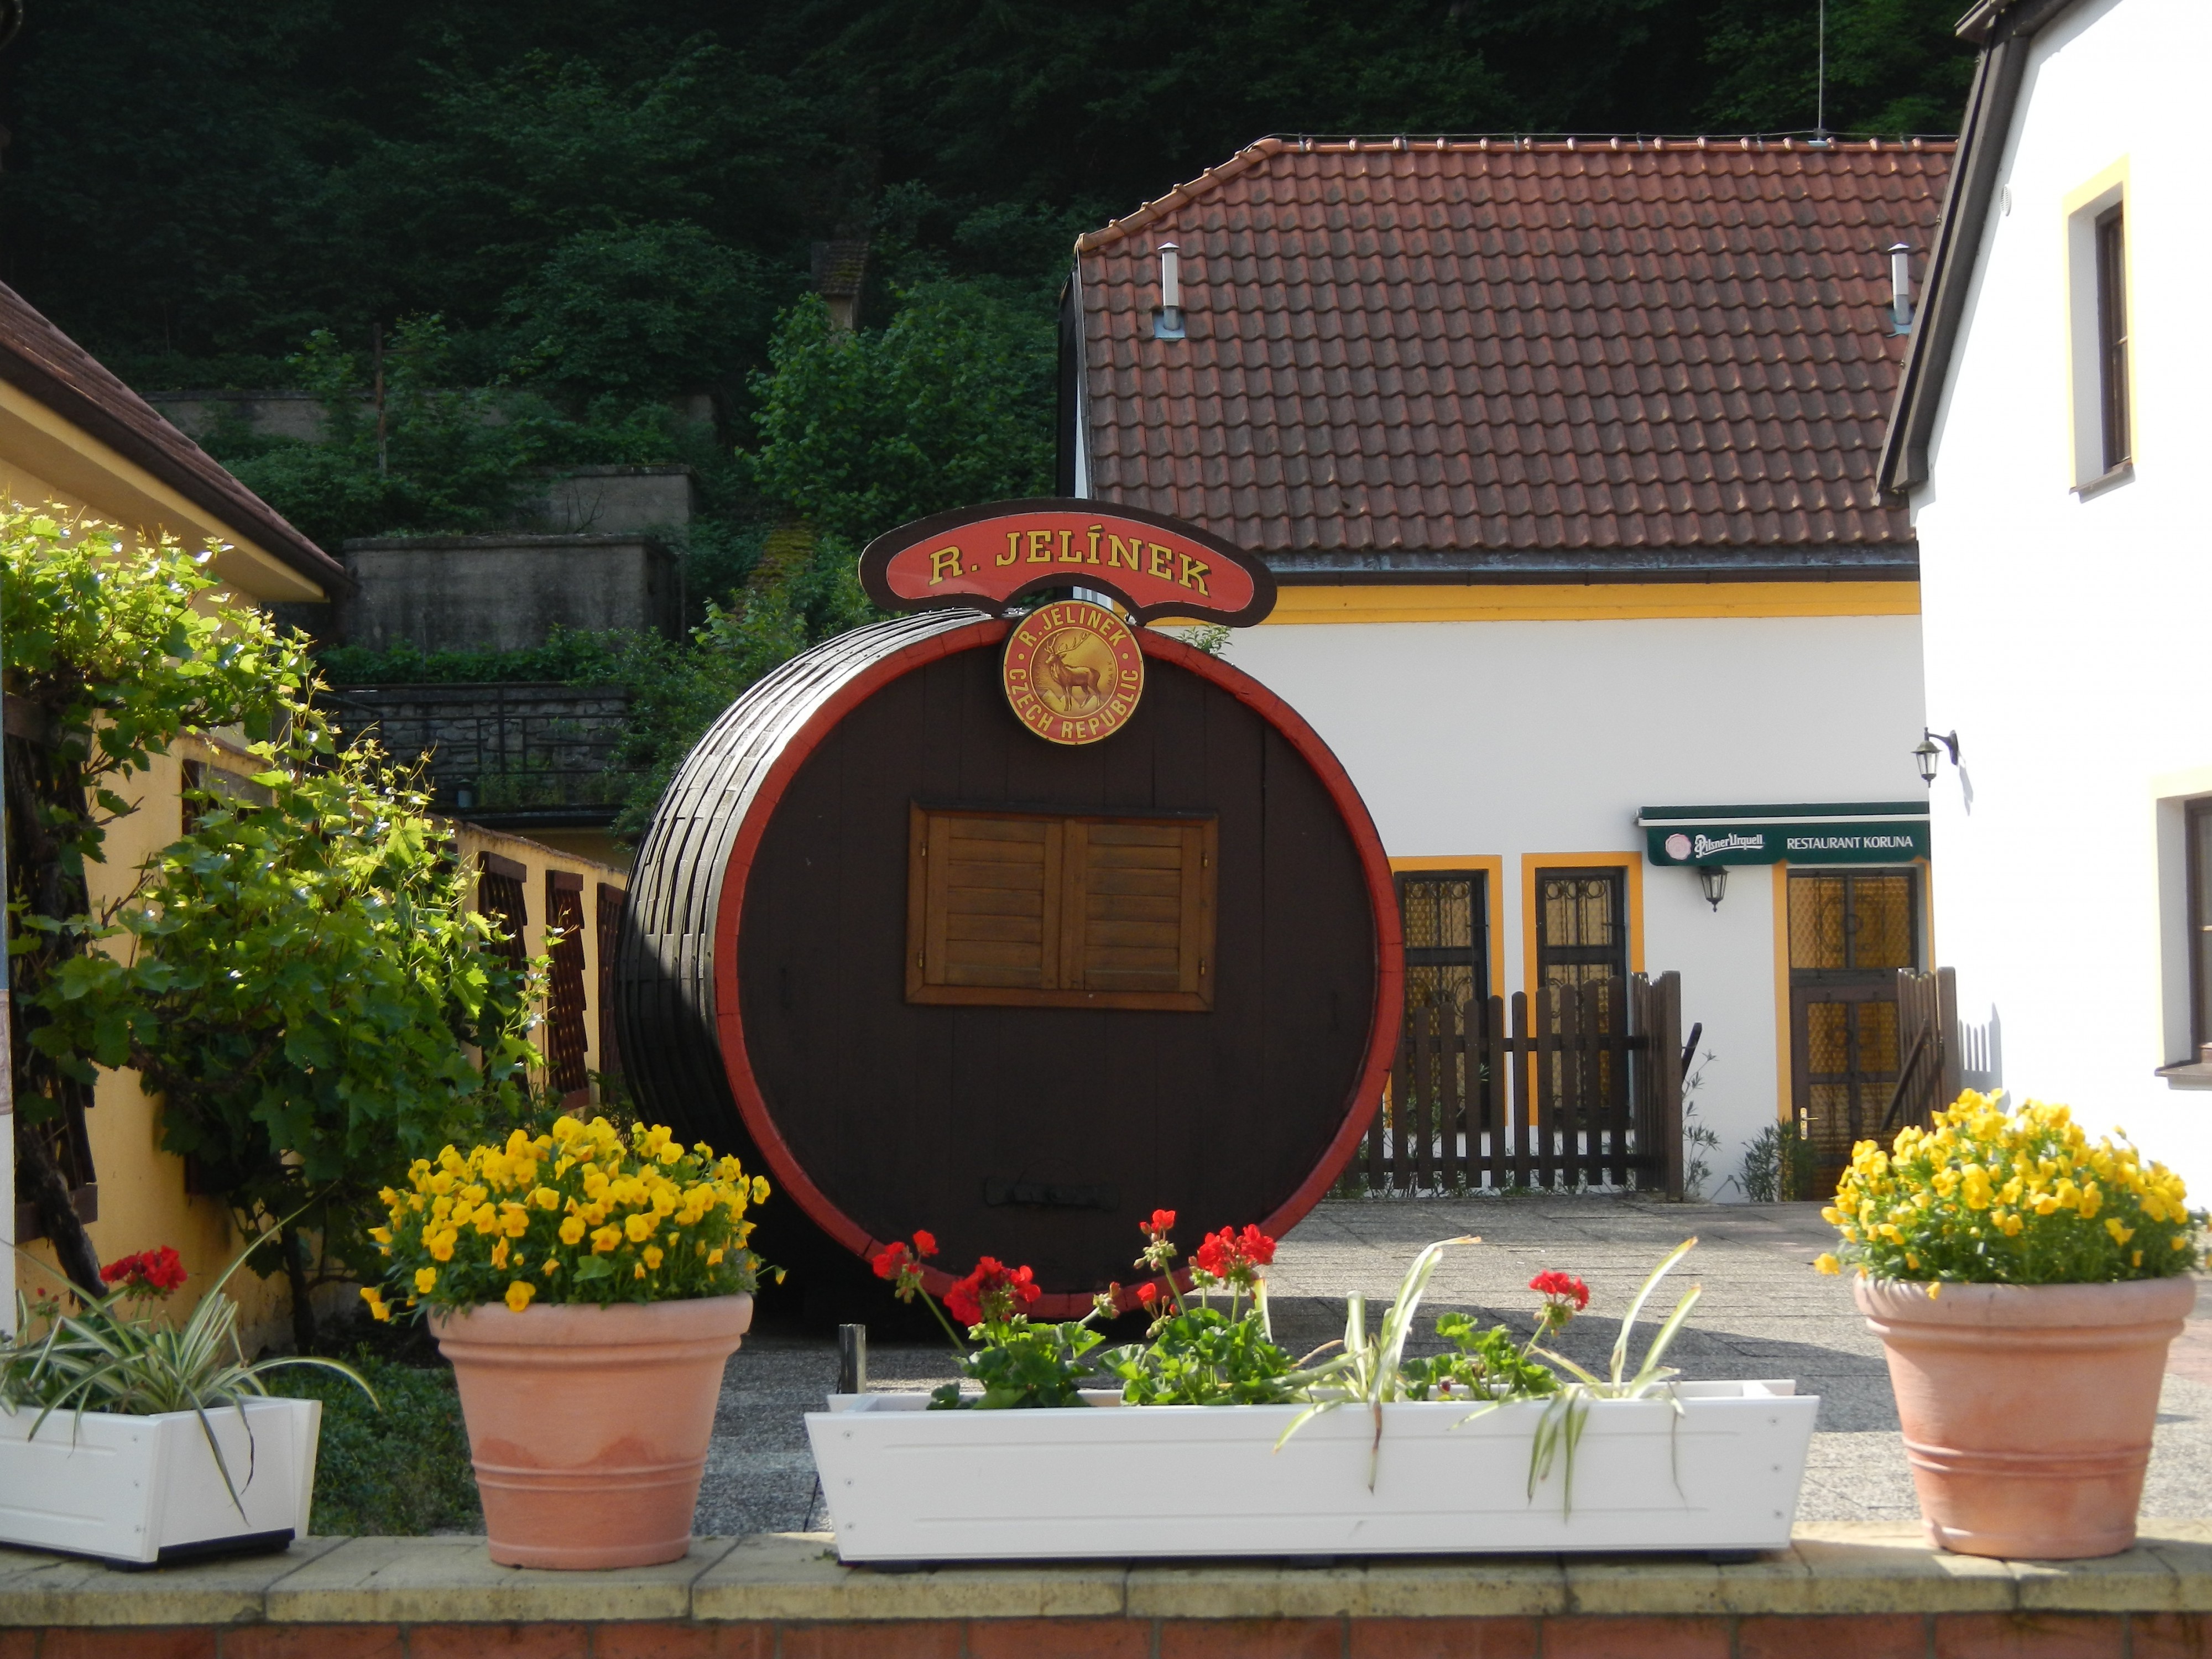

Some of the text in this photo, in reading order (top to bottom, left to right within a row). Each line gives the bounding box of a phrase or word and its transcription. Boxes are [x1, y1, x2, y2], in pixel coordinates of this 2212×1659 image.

[928, 524, 1212, 597] R. JELÍNEK
[1009, 668, 1139, 739] CZECH REPUBLIC
[1694, 833, 1763, 858] Pilsner Urquell
[1787, 836, 1913, 849] RESTAURANT KORUNA
